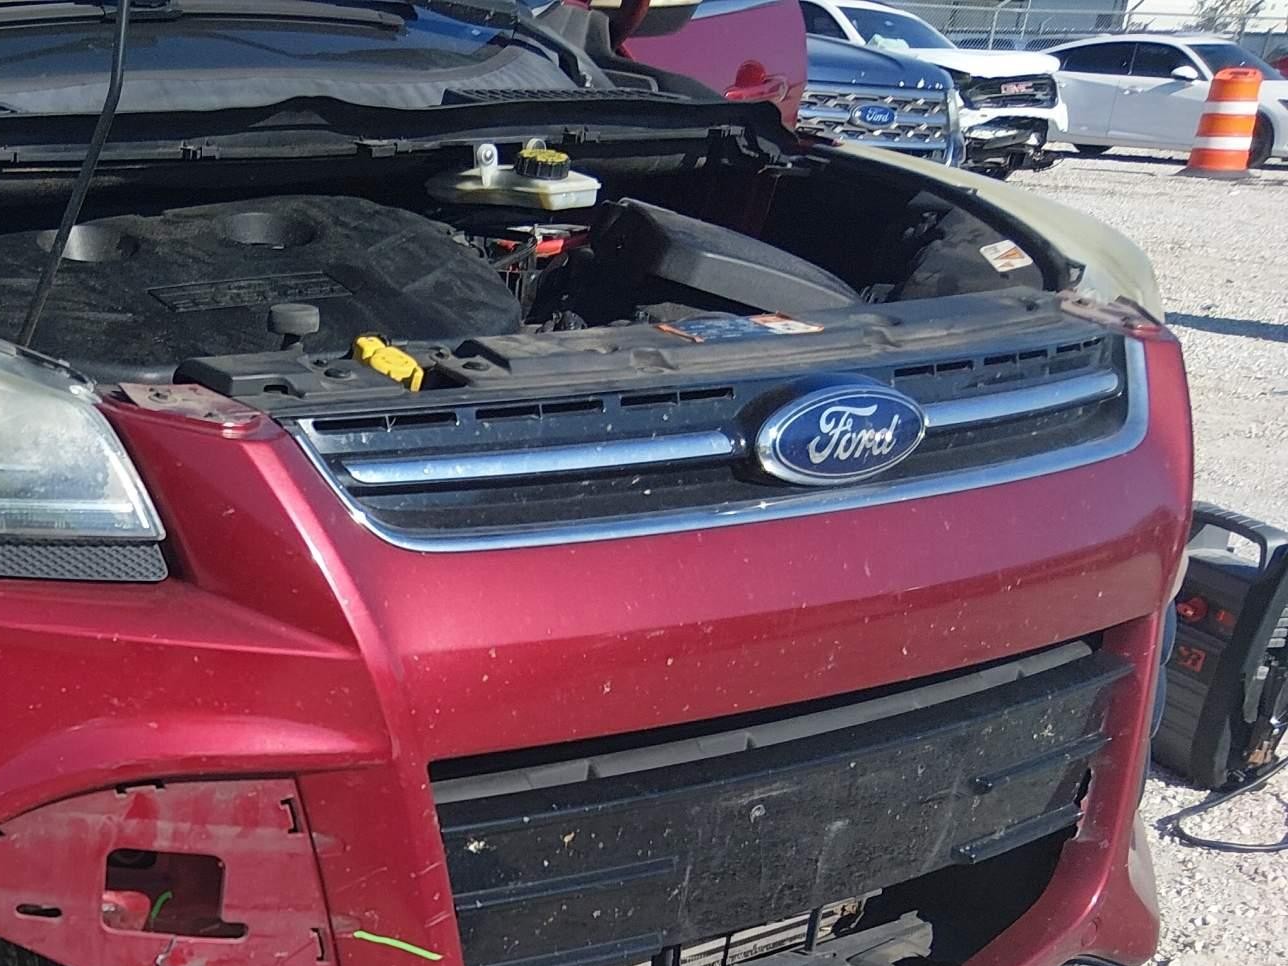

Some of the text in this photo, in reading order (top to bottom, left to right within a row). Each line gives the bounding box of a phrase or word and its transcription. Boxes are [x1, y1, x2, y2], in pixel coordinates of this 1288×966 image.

[1000, 81, 1034, 94] GMC
[865, 107, 891, 122] Ford
[807, 404, 899, 465] Ford
